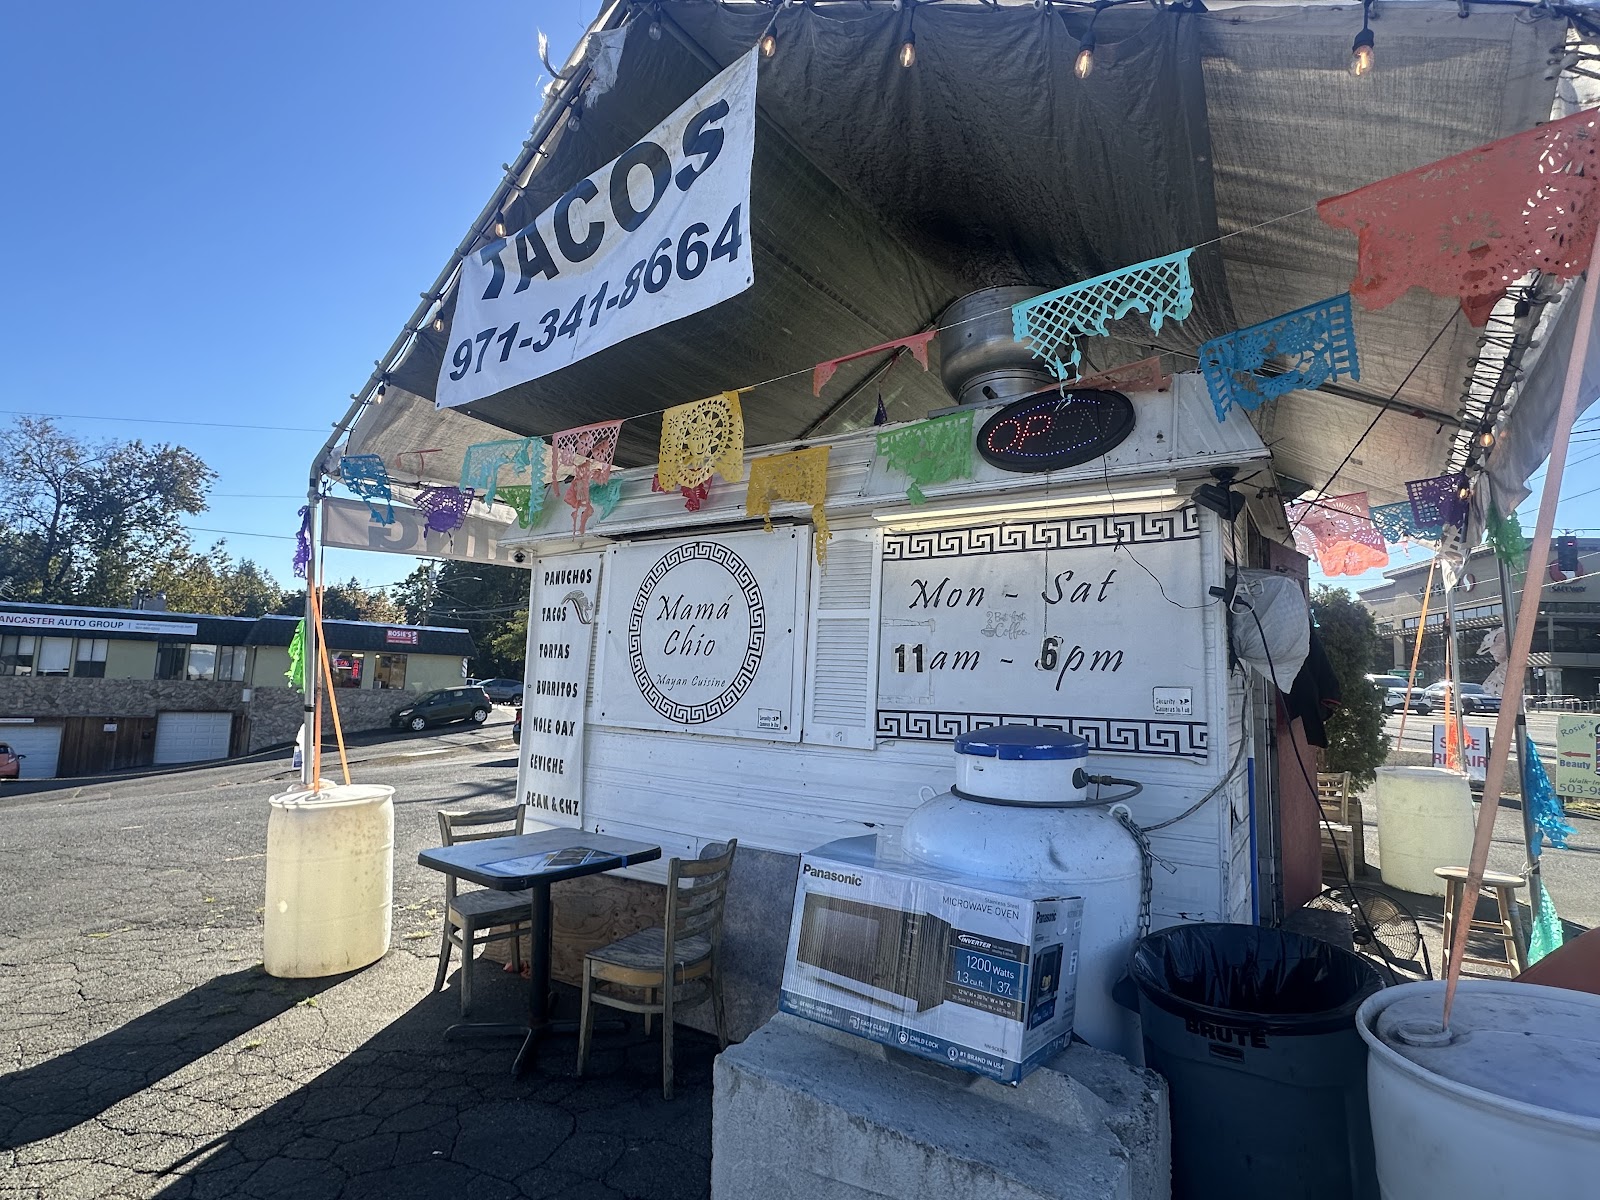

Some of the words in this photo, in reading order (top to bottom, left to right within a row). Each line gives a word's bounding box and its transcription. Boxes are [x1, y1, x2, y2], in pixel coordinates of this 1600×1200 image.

[481, 98, 730, 300] TACOS
[449, 203, 743, 382] 971-341-8664
[544, 567, 593, 587] PANUCHOS
[908, 576, 985, 610] Mon
[1041, 568, 1118, 605] Sat
[541, 606, 567, 623] TACOS
[656, 594, 733, 621] Mamá
[57, 618, 86, 628] AUTO
[88, 620, 124, 629] GROUP
[387, 630, 412, 638] ROSIE'S
[539, 642, 570, 660] TORTAS
[663, 624, 716, 657] Chio
[894, 642, 981, 674] 11am
[1038, 636, 1124, 692] 6pm
[536, 678, 579, 699] BURRITOS
[656, 673, 688, 691] Mayan
[691, 676, 726, 689] Cuisine
[533, 716, 553, 735] MOLE
[555, 718, 576, 738] OAX
[1560, 719, 1594, 737] Rosie's
[530, 753, 564, 776] CEVICHE
[1559, 759, 1591, 770] Beauty
[526, 790, 550, 811] BEAN
[551, 796, 558, 813] &
[559, 797, 580, 817] CHZ
[802, 863, 863, 887] Panasonic
[942, 896, 993, 914] MICROWAVE
[995, 907, 1020, 920] OVEN
[960, 937, 992, 949] INVERTER
[956, 970, 969, 984] 1.3
[966, 955, 992, 973] 1200
[992, 966, 1015, 979] Watts
[909, 1035, 925, 1046] CHILD
[925, 1040, 939, 1050] LOCK
[1185, 1016, 1269, 1049] BRUTE
[967, 1053, 986, 1065] BRAND
[993, 1061, 1005, 1071] USA
